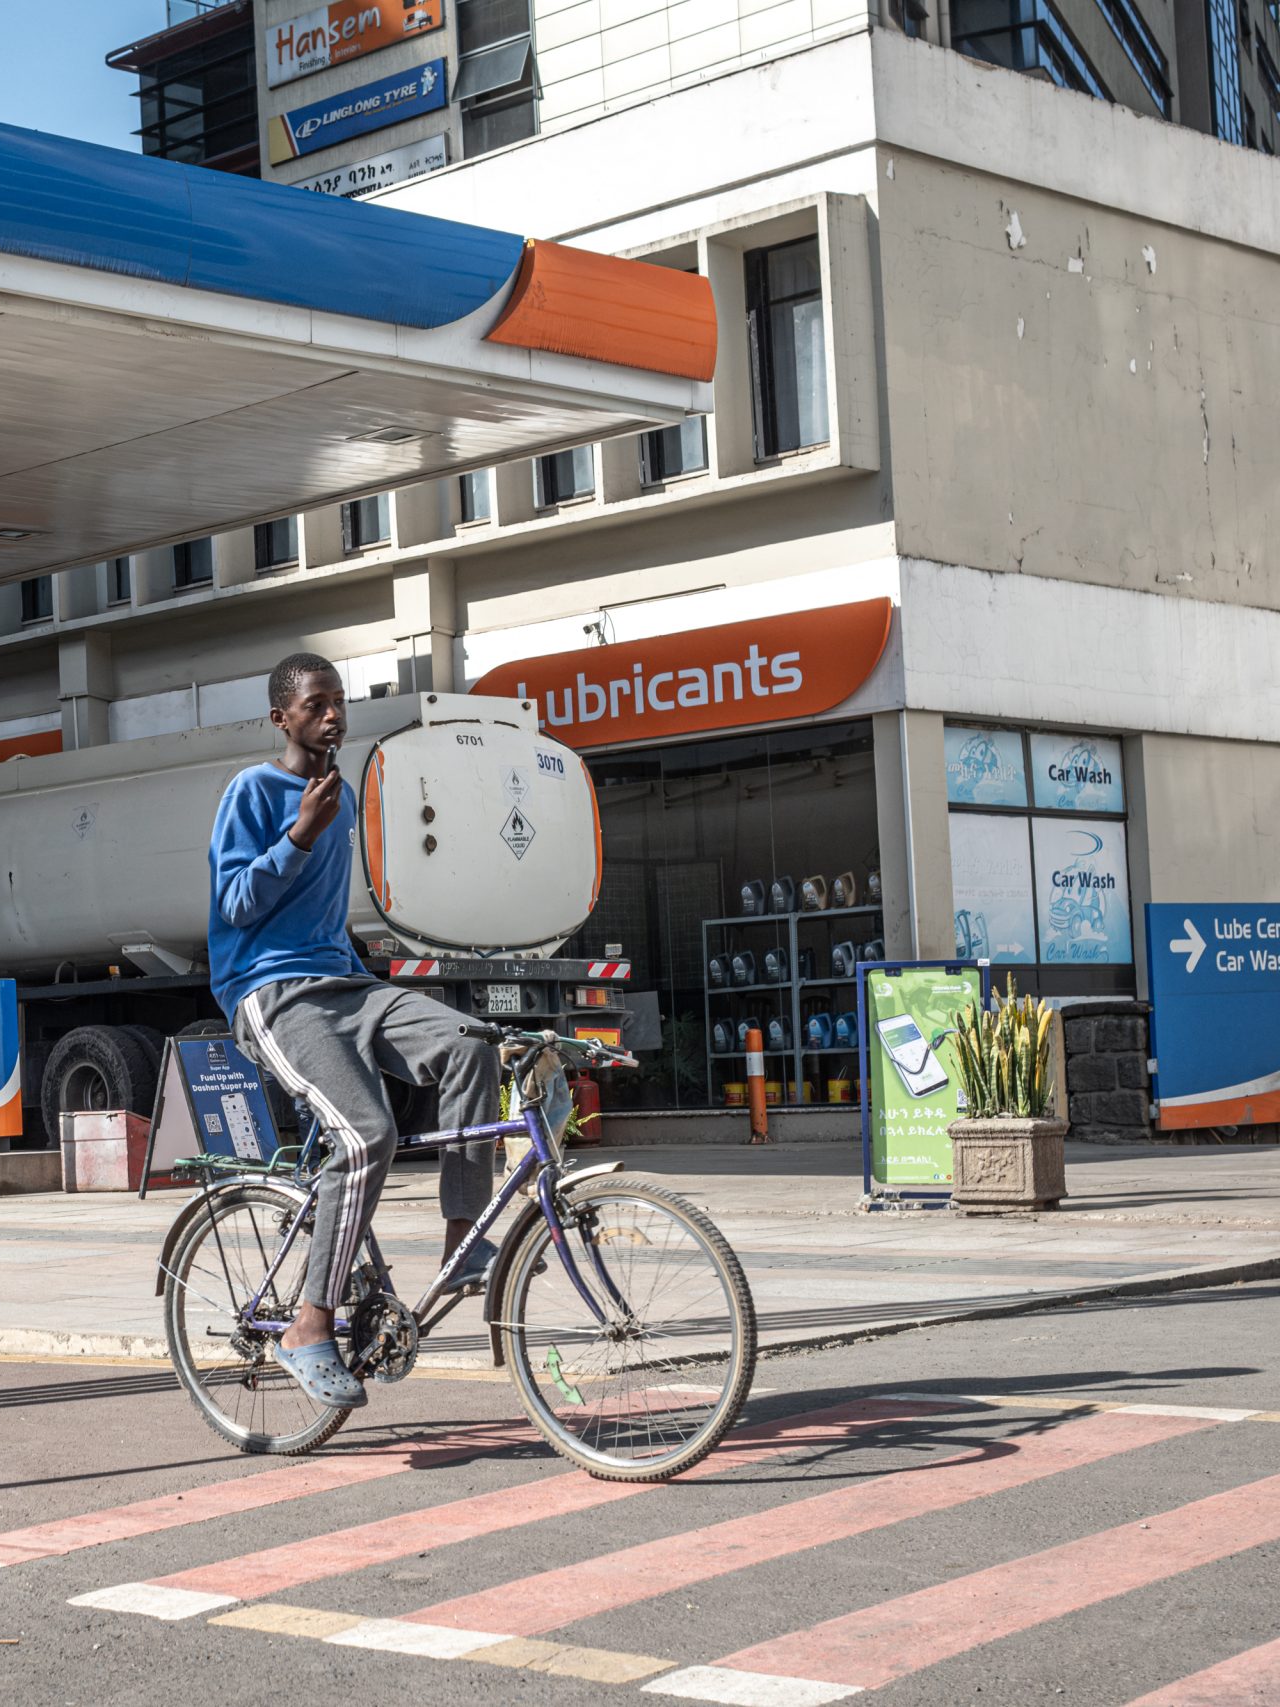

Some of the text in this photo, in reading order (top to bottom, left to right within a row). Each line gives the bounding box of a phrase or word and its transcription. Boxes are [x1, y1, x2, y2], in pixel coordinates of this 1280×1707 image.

[276, 6, 381, 65] Hansem
[323, 95, 381, 125] LINGLONG
[384, 82, 418, 103] TYRE
[456, 733, 484, 747] 6701
[537, 752, 564, 774] 3070
[1049, 764, 1111, 784] Car Wash
[1052, 870, 1115, 889] Car Wash
[1215, 918, 1251, 939] Lube
[1046, 943, 1100, 962] Car Wash
[1217, 950, 1280, 971] Car Wa
[490, 1000, 513, 1011] 28711
[192, 1081, 258, 1092] Dashen Super App
[217, 1074, 226, 1082] Up
[227, 1072, 244, 1080] with
[454, 1192, 502, 1260] FLYING PIGEON
